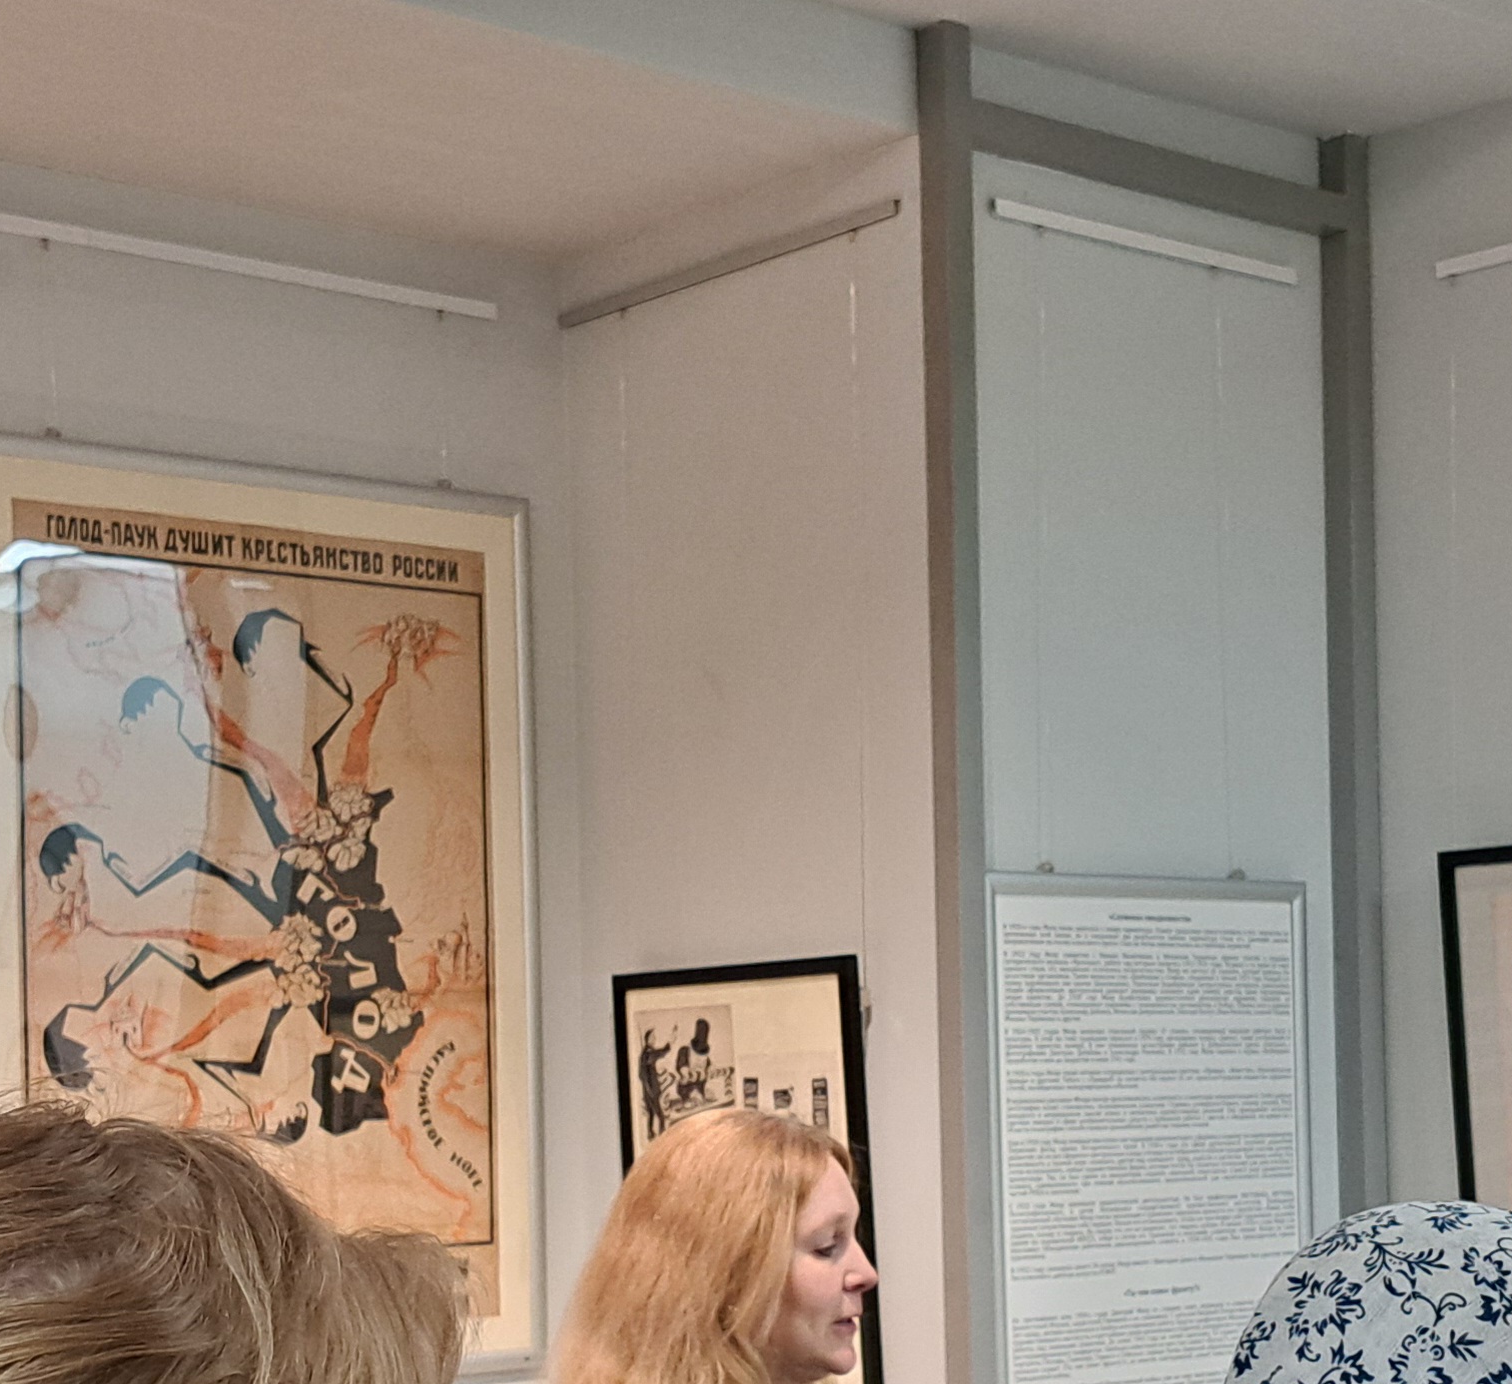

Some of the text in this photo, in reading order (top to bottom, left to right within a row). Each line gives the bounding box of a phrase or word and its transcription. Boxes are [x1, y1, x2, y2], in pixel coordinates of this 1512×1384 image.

[46, 513, 460, 584] ГОЛОД-ПАУК ДУШИТ КРЕСТЬЯНСТВО РОССИИ
